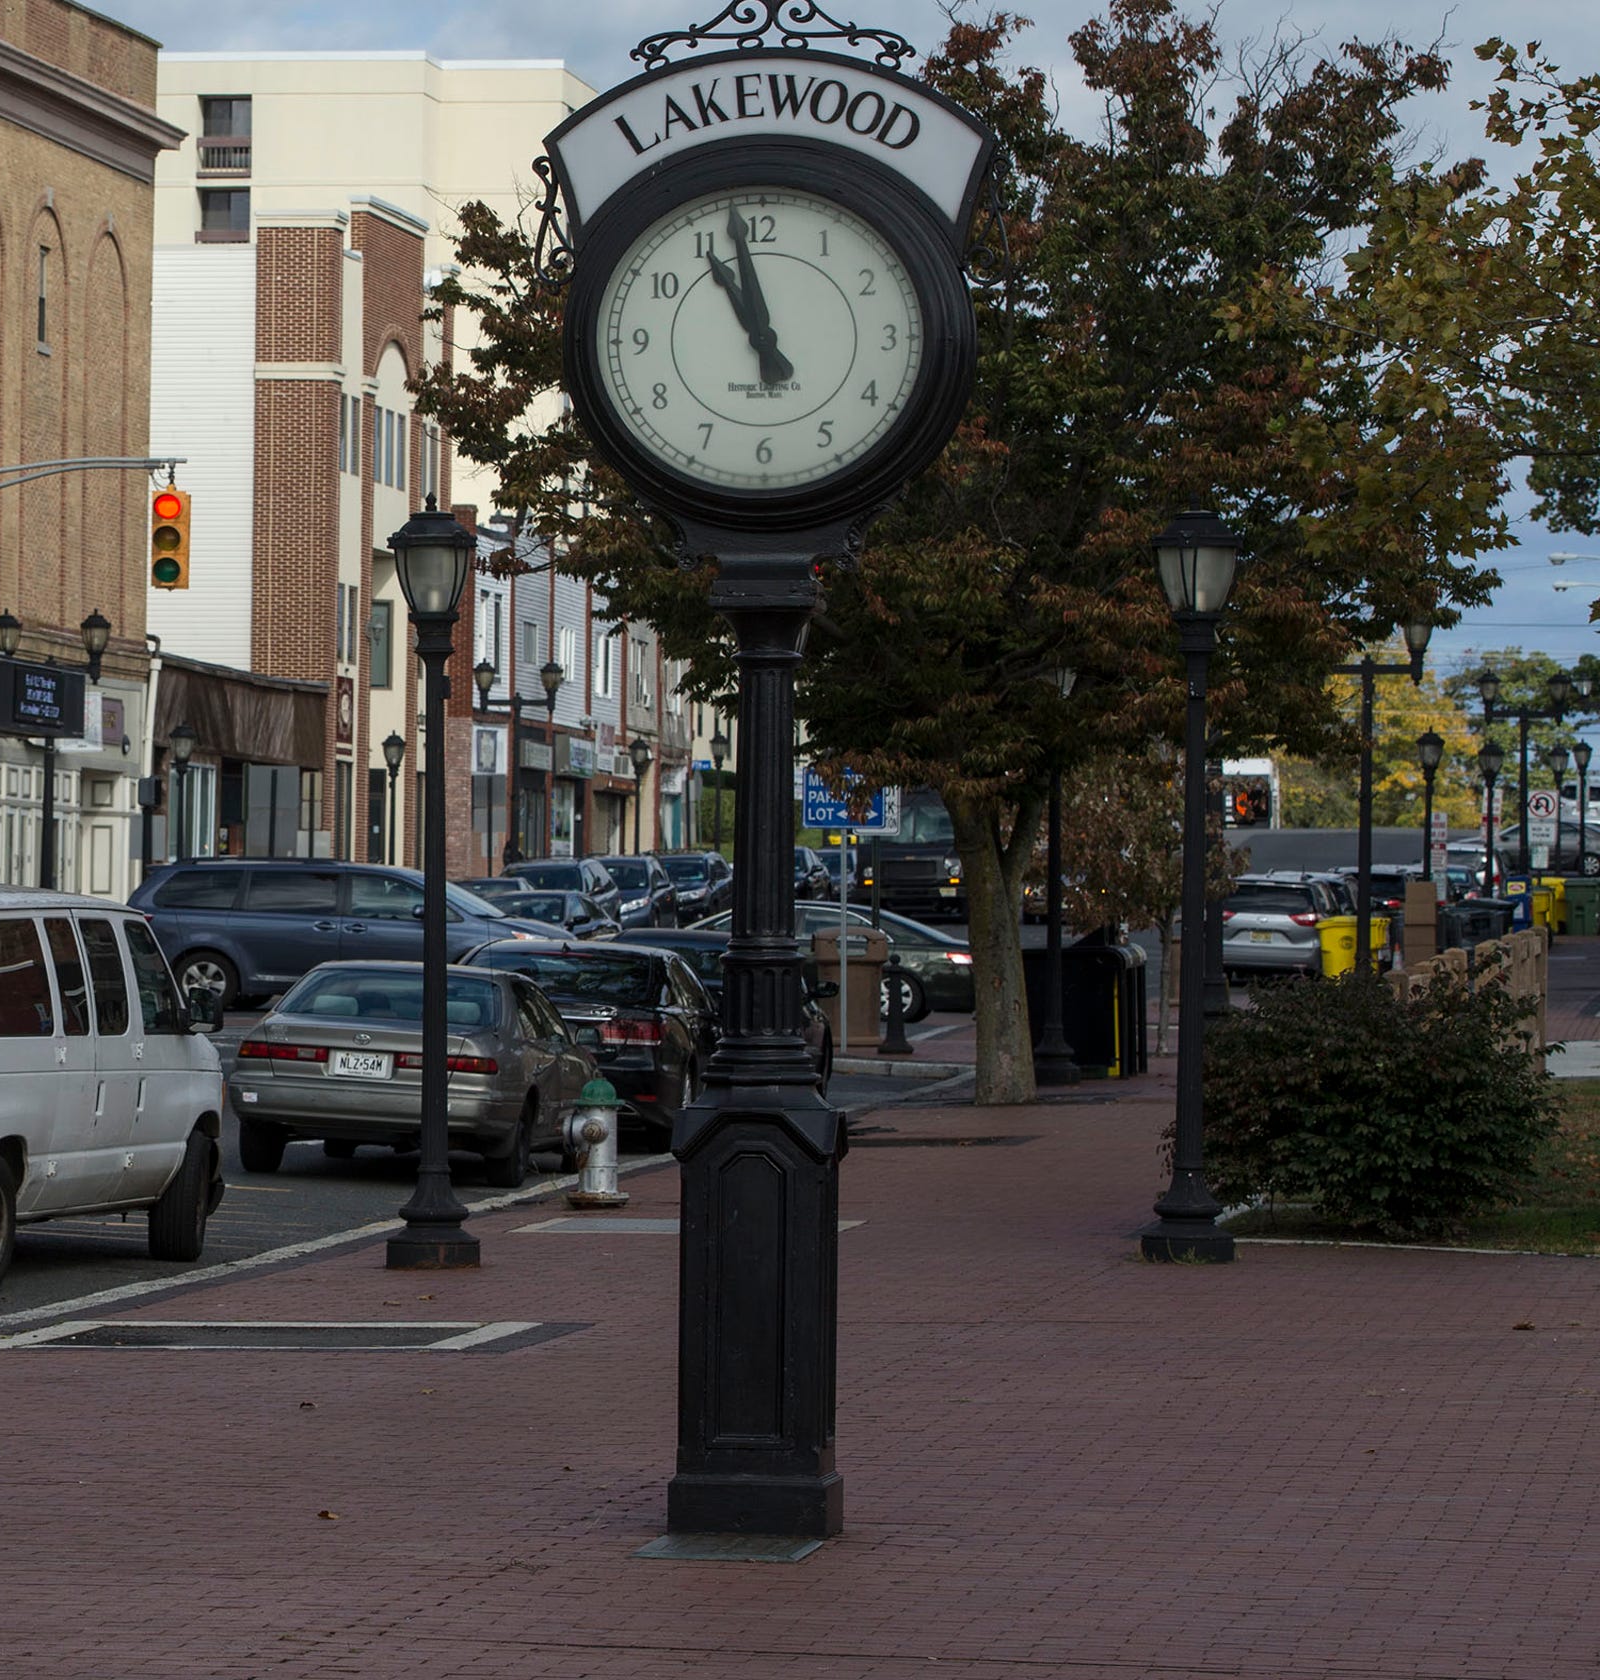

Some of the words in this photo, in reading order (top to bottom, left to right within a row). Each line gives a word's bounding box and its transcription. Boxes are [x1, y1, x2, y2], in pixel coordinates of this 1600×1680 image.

[613, 72, 921, 155] LAKEWOOD
[747, 215, 777, 243] 12
[695, 231, 715, 258] 11
[819, 230, 829, 256] 1
[650, 272, 679, 299] 10
[858, 269, 876, 296] 2
[633, 328, 649, 356] 9
[880, 324, 897, 351] 3
[652, 383, 668, 409] 8
[860, 380, 878, 407] 4
[698, 423, 713, 450] 7
[817, 420, 834, 448] 5
[756, 437, 772, 464] 6
[808, 807, 835, 821] LOT
